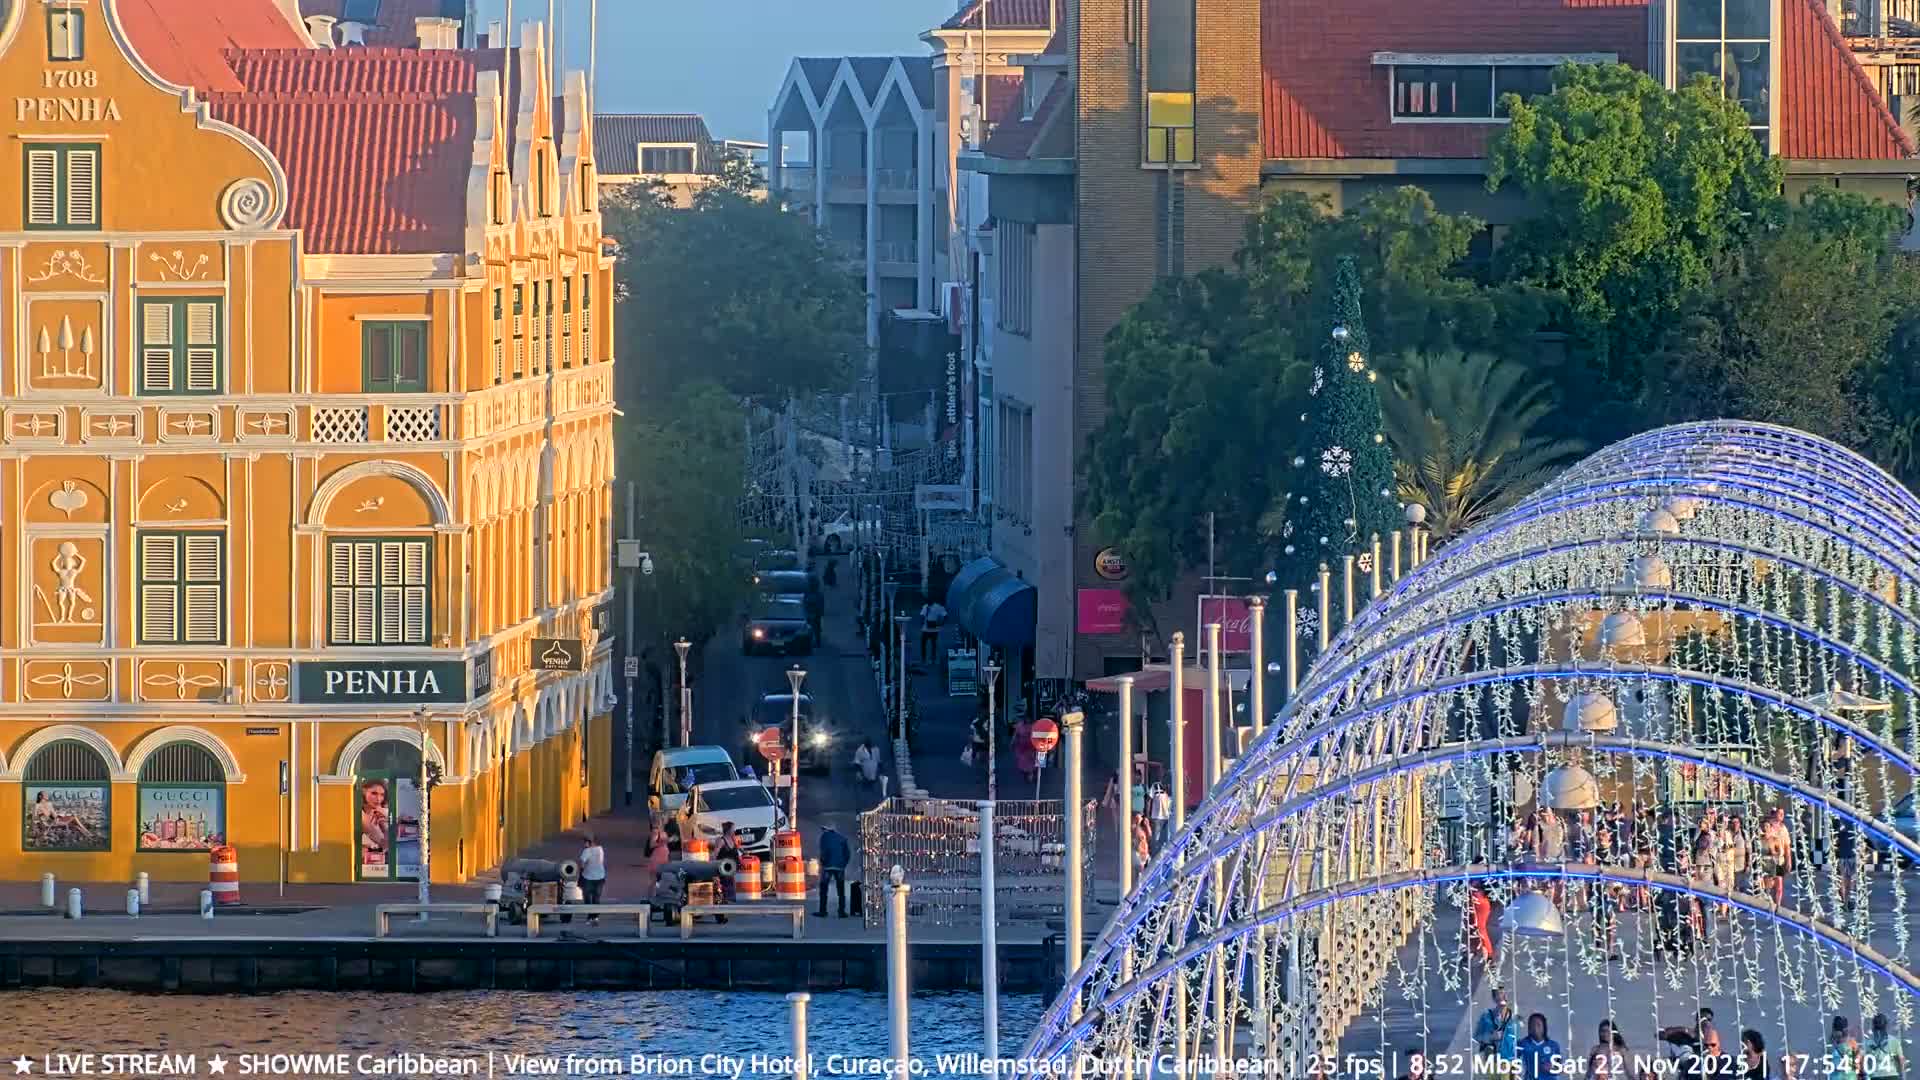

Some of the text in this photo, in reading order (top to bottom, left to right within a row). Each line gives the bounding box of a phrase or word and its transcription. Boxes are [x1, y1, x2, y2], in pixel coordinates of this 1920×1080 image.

[42, 69, 97, 88] 1708
[16, 97, 121, 121] PENHA
[945, 351, 957, 376] foot
[545, 657, 568, 665] PENHA
[324, 670, 441, 695] PENHA
[52, 790, 105, 800] GUCCI
[153, 791, 209, 801] GUCCI
